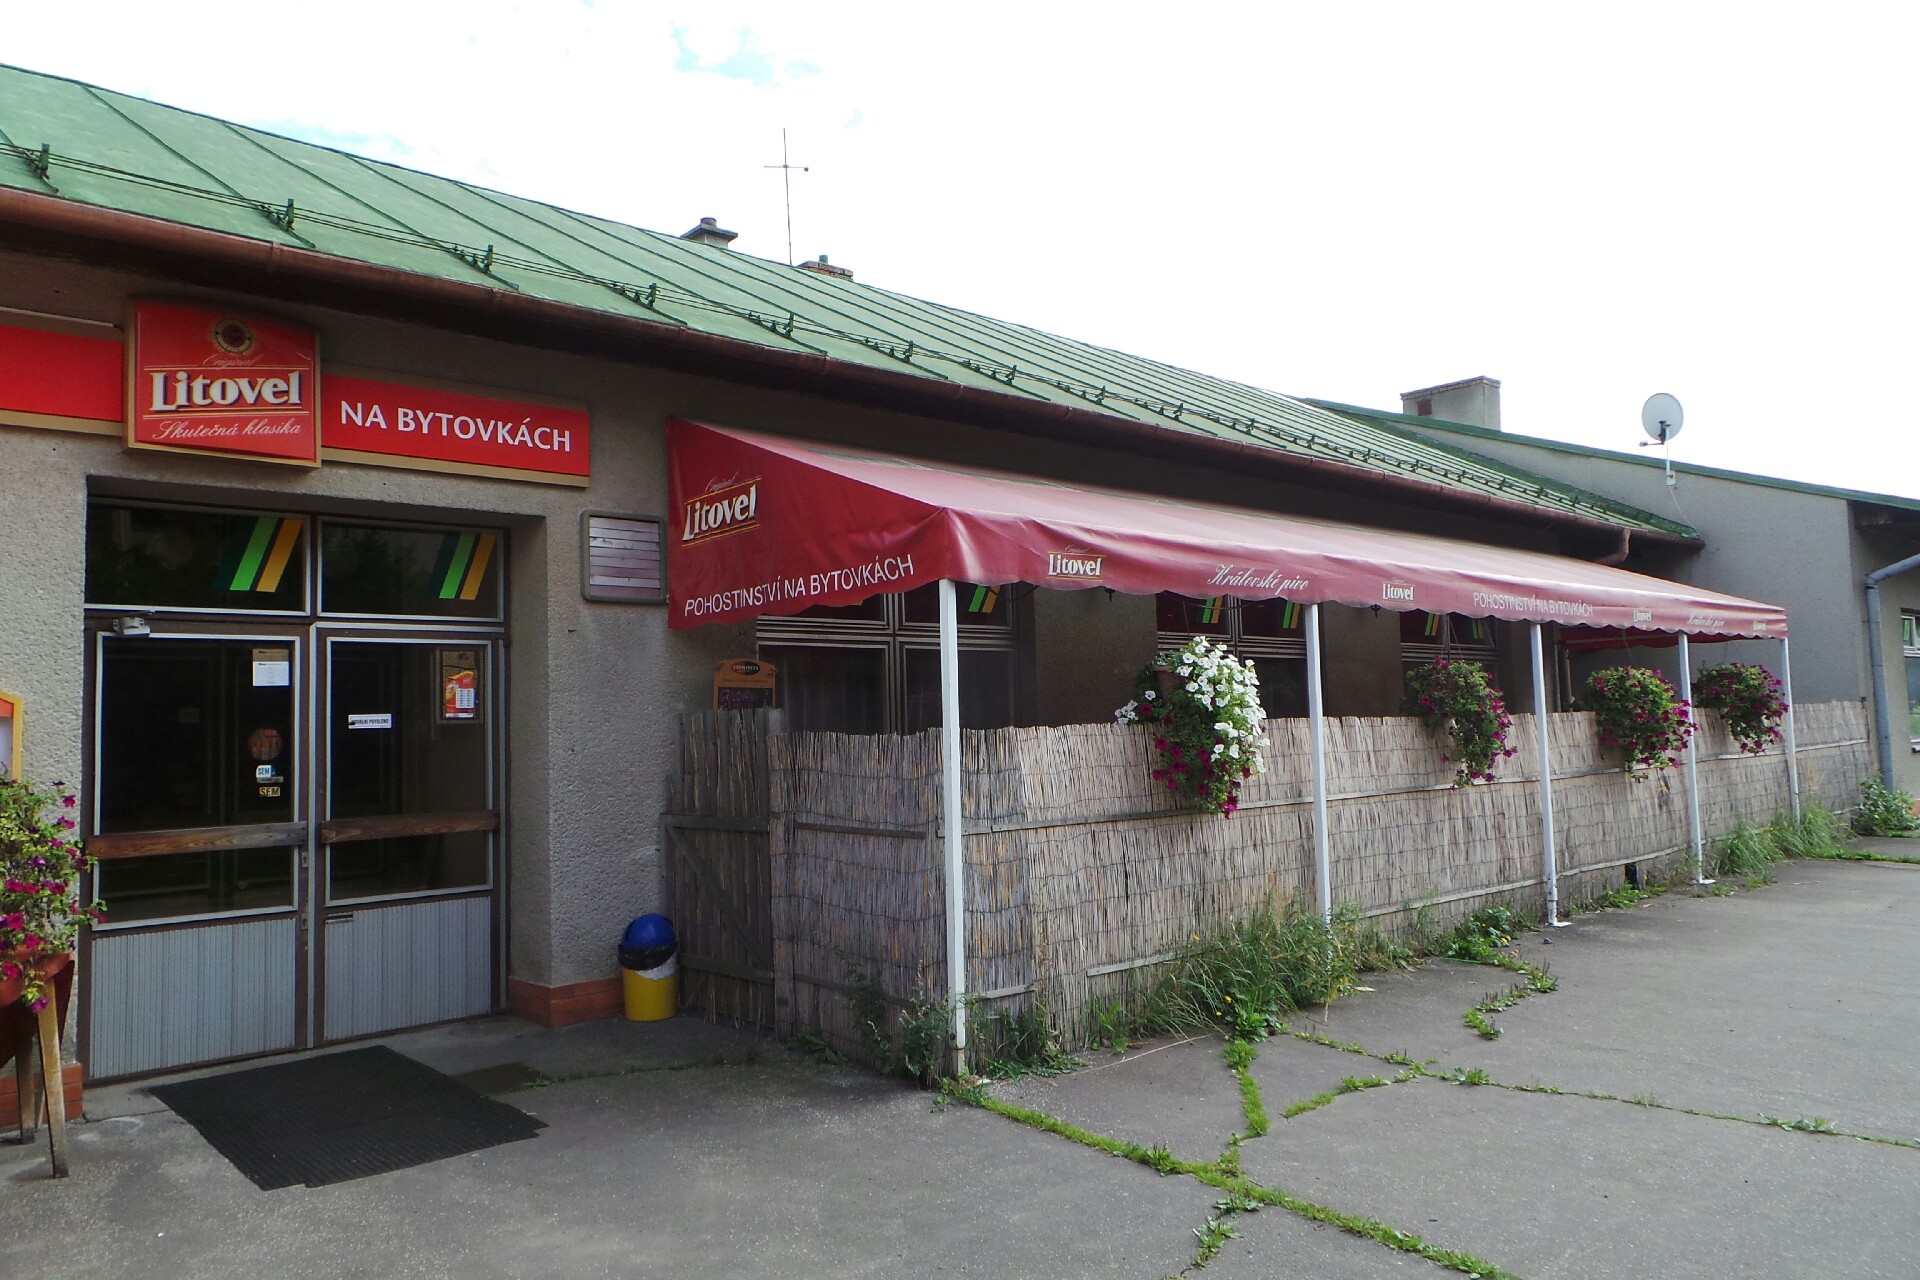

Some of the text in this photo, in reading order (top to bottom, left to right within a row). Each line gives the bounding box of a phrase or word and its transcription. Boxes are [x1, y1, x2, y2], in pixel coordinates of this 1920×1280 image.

[149, 370, 302, 412] Litovel
[152, 417, 301, 440] Skutečná klasika
[340, 400, 571, 452] NA BYTOVKÁCH
[681, 484, 757, 541] Litovel
[1048, 553, 1103, 576] Litovel
[684, 554, 915, 617] POHOSTINSTVÍ NA BYTOVKÁCH
[1207, 563, 1309, 596] Královské pivo
[1382, 583, 1414, 601] Litovel
[1473, 592, 1594, 617] POHOSTINSTVÍ NA BYTOVKÁCH
[259, 787, 279, 796] SEM
